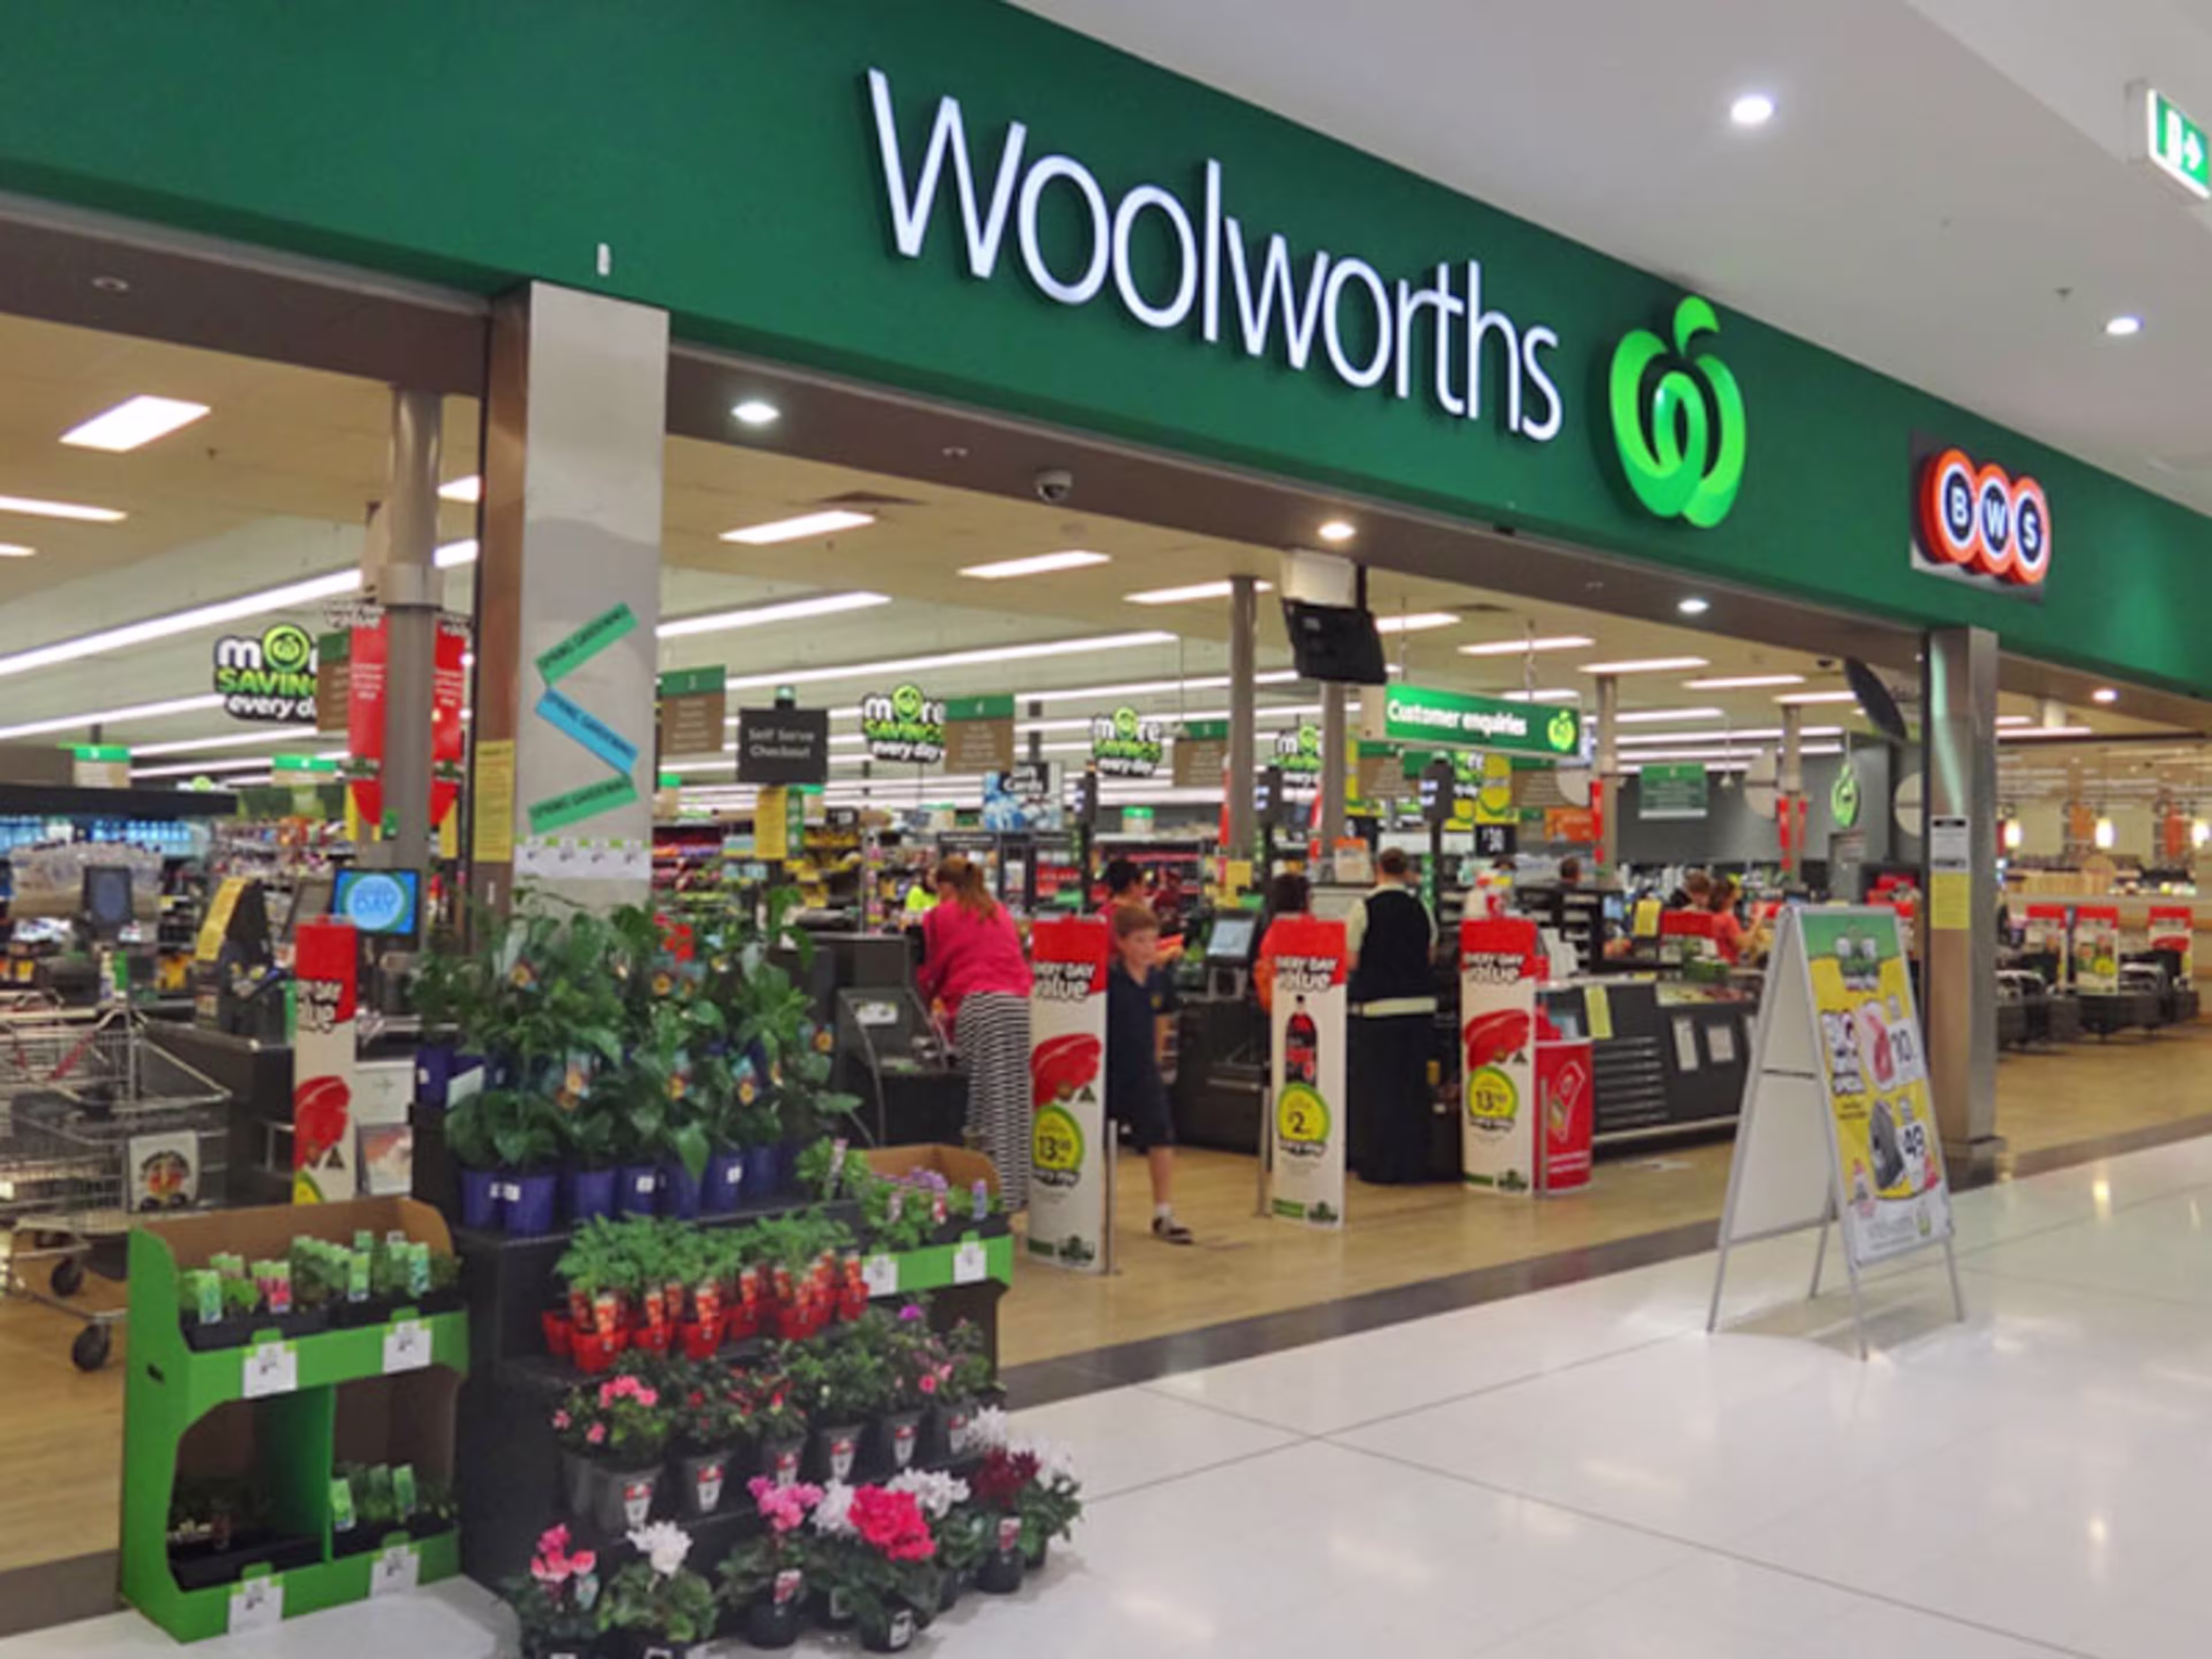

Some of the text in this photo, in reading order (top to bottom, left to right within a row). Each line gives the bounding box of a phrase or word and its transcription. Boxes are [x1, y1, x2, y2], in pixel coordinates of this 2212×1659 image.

[867, 67, 1562, 442] Woolworths
[218, 668, 316, 695] SAVIN
[229, 695, 294, 719] every
[1387, 698, 1528, 738] Customer enquiries
[749, 728, 815, 743] Self Serve
[749, 744, 810, 759] Checkout
[1066, 962, 1096, 978] DAY
